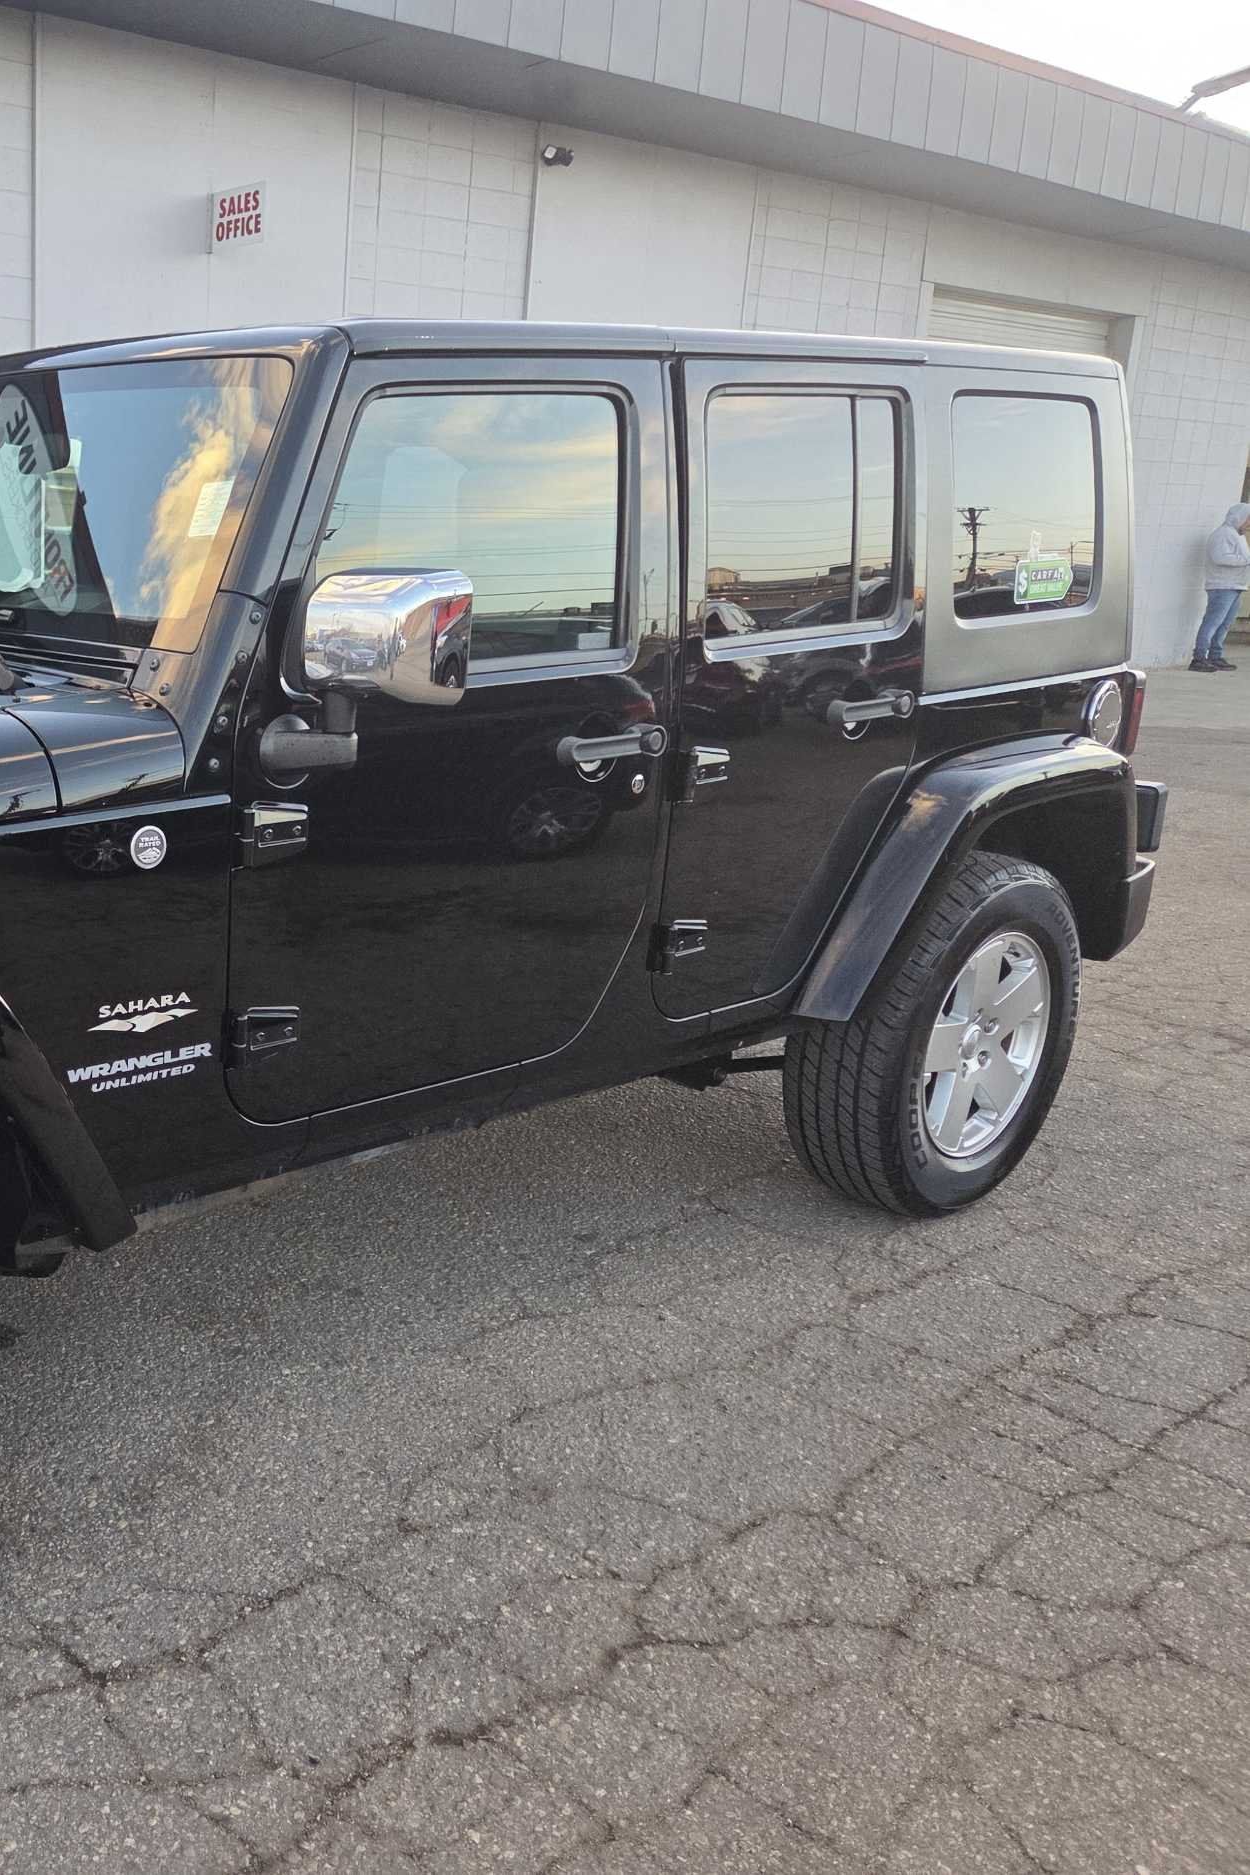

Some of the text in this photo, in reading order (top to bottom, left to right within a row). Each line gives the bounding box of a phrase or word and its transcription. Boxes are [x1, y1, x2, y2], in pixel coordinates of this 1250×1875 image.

[219, 190, 260, 219] SALES
[216, 213, 262, 242] OFFICE
[98, 991, 191, 1019] SAHARA
[67, 1042, 213, 1084] WRANGLER
[91, 1063, 196, 1094] UNLIMITED
